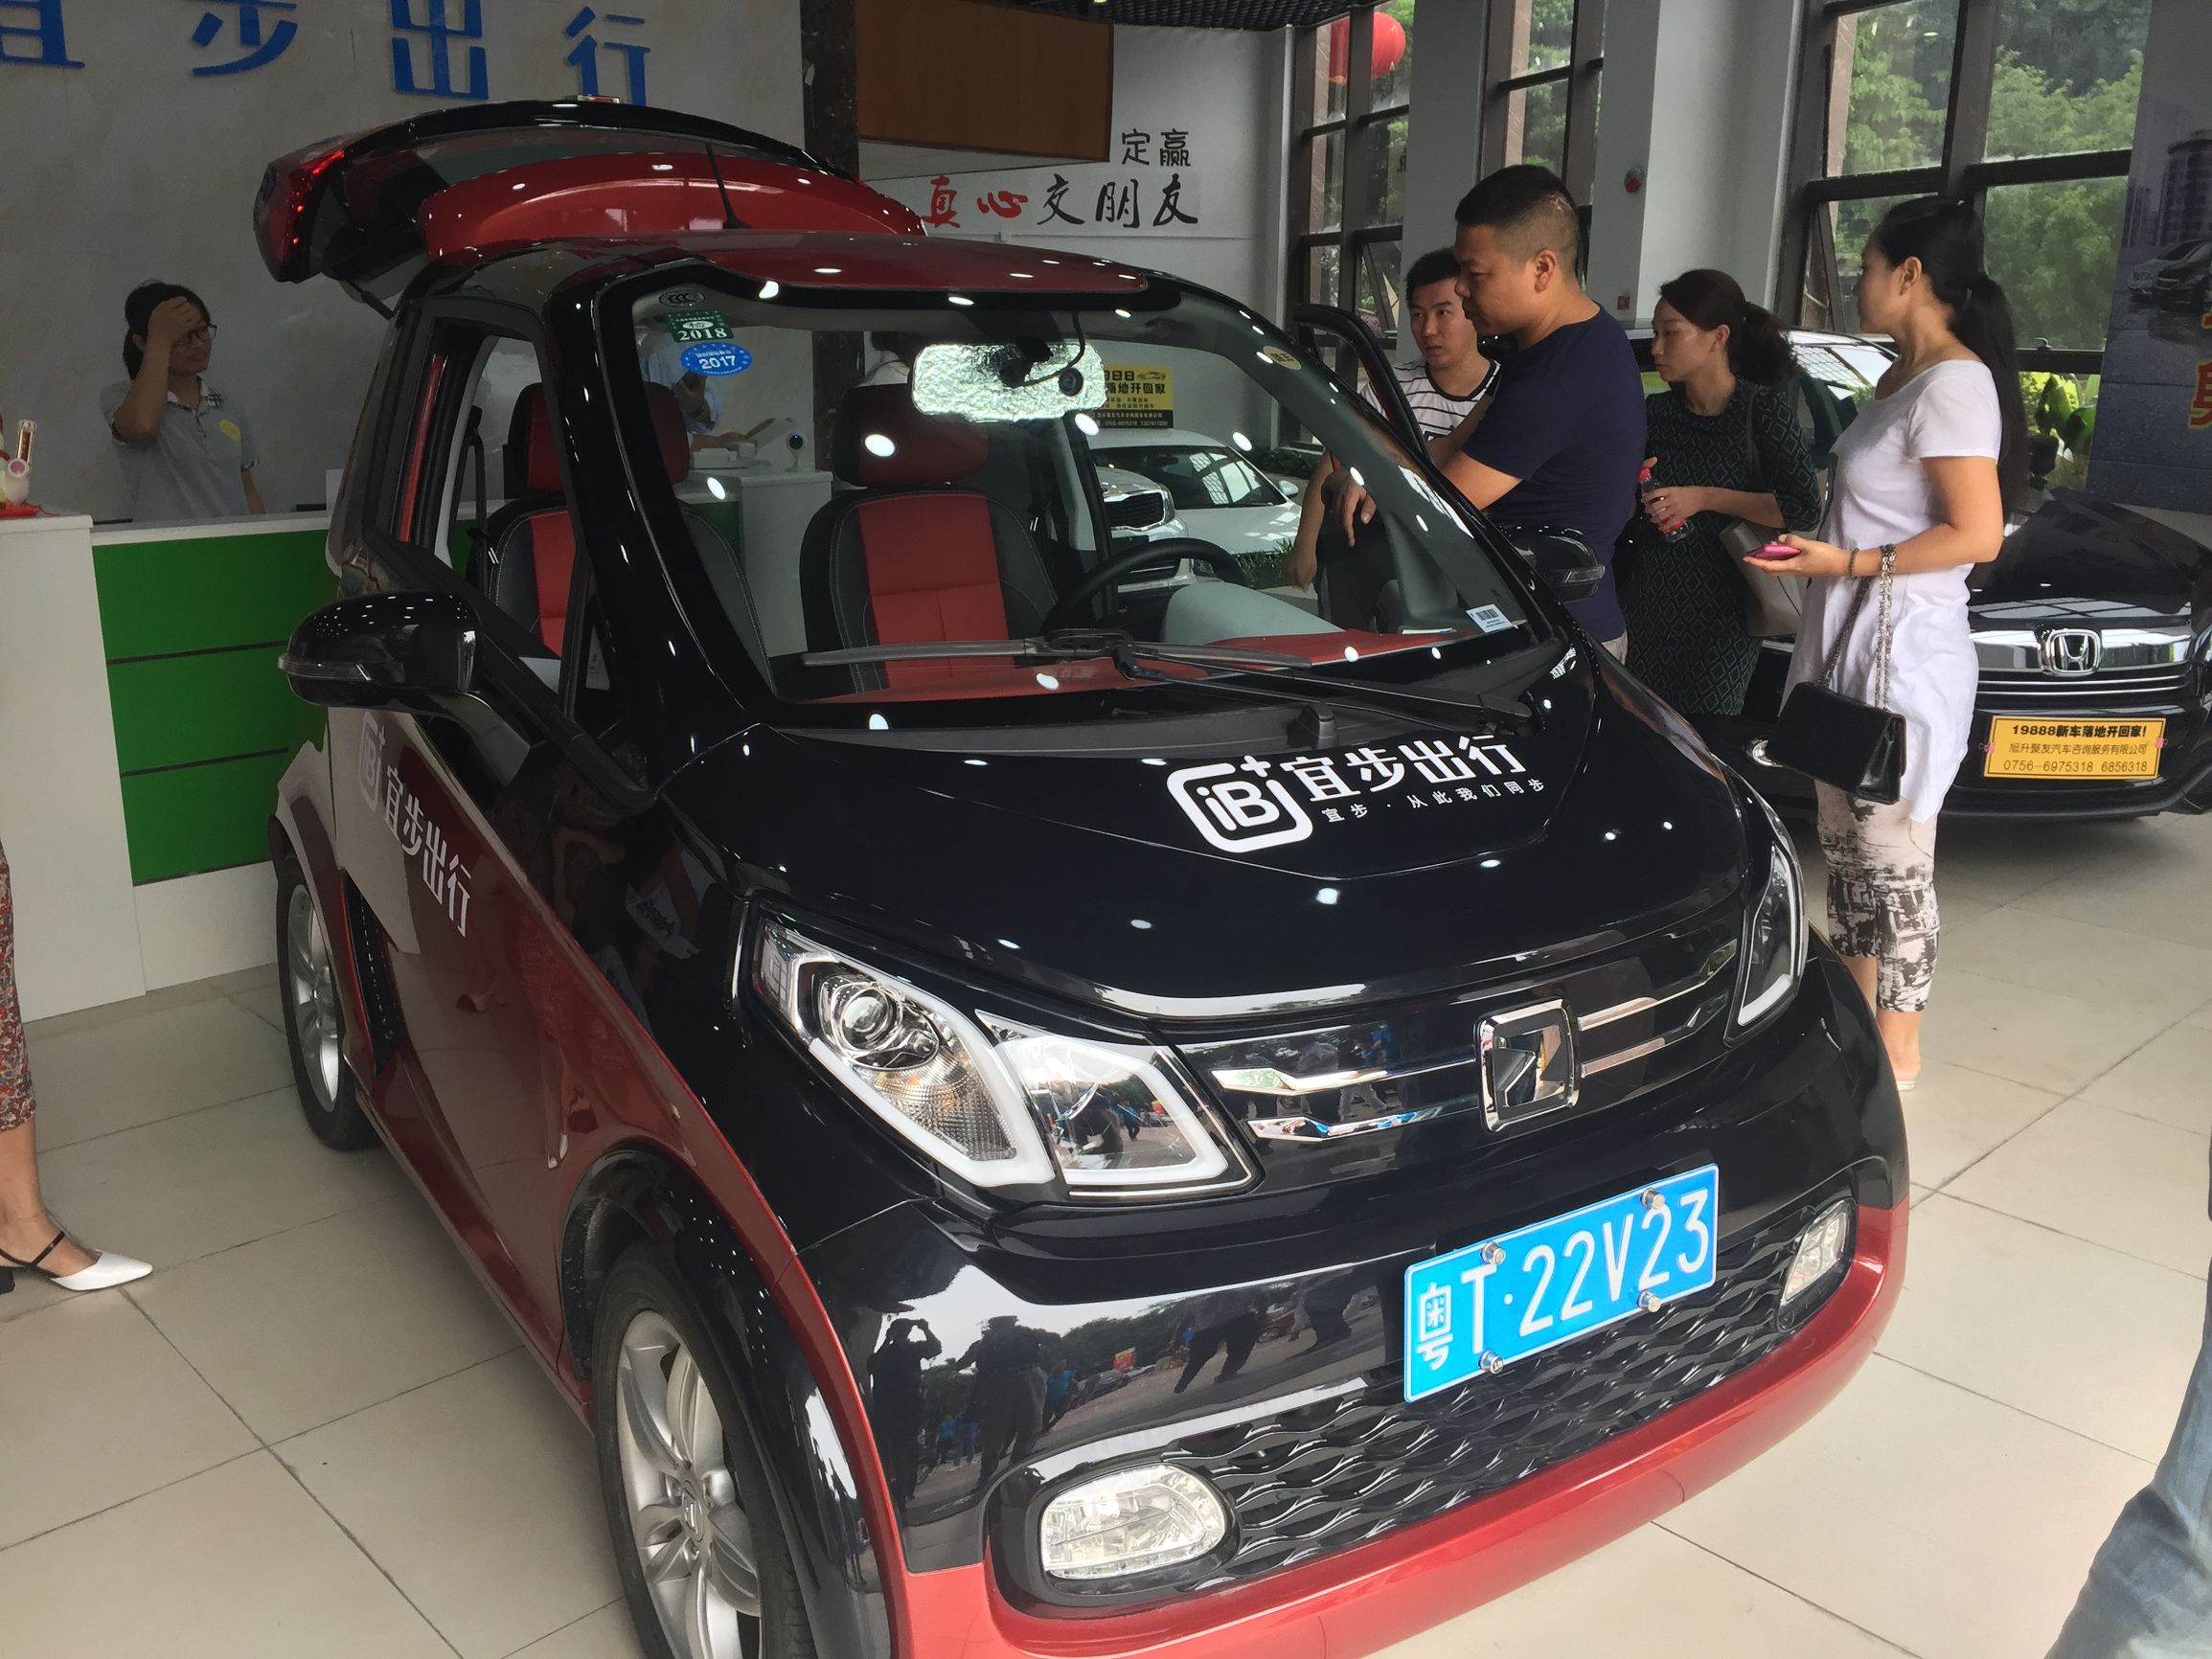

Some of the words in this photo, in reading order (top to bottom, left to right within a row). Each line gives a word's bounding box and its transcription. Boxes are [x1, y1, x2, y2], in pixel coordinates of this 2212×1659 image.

[1121, 128, 1191, 167] 定赢
[921, 173, 1198, 229] 真心交朋友
[677, 328, 727, 341] 2018
[698, 355, 737, 370] 2017
[2003, 760, 2093, 773] 0756-6975318
[2101, 761, 2148, 773] 6856318
[2009, 742, 2148, 756] 旭升聚友汽车咨询服务有限公司
[1279, 735, 1527, 803] 宜步出行
[384, 764, 471, 938] 宜步出行
[1417, 1188, 1710, 1371] 粤T·22V23
